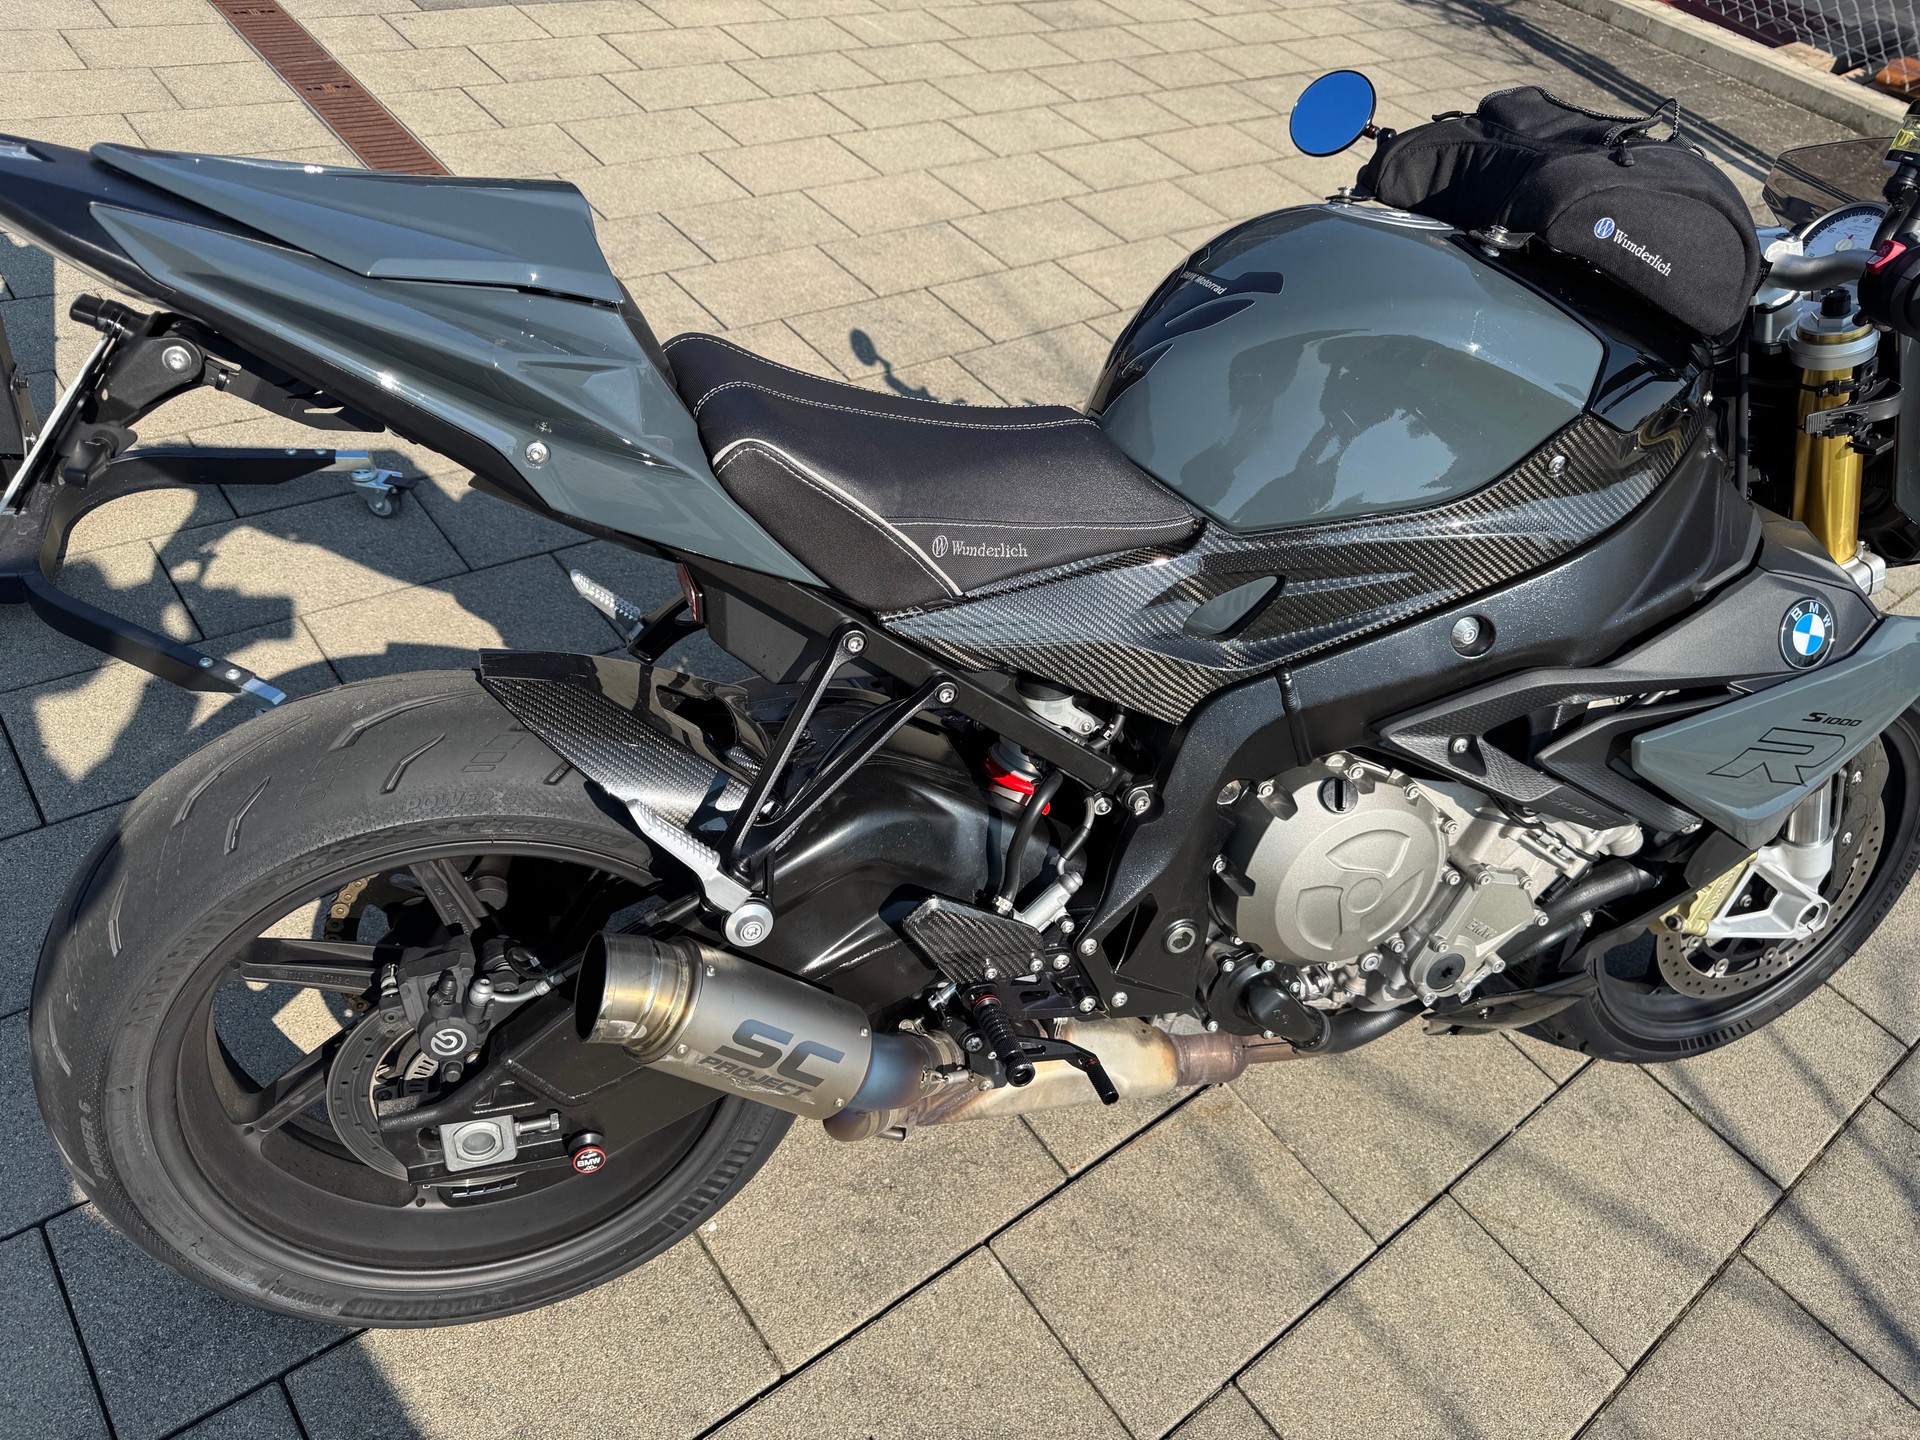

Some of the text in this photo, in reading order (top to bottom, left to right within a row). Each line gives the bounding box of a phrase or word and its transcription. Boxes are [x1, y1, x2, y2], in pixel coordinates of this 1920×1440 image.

[1613, 229, 1672, 277] Wunderlich
[1194, 275, 1228, 295] Motorrad
[952, 540, 1029, 558] Wunderlich
[1790, 601, 1832, 629] BMW
[1706, 727, 1847, 788] R
[402, 790, 495, 813] POWER
[469, 821, 622, 846] MICHELIN
[713, 1018, 846, 1088] SC
[697, 1055, 813, 1098] PROJECT
[80, 1116, 109, 1180] POWER
[576, 1156, 601, 1168] BMW
